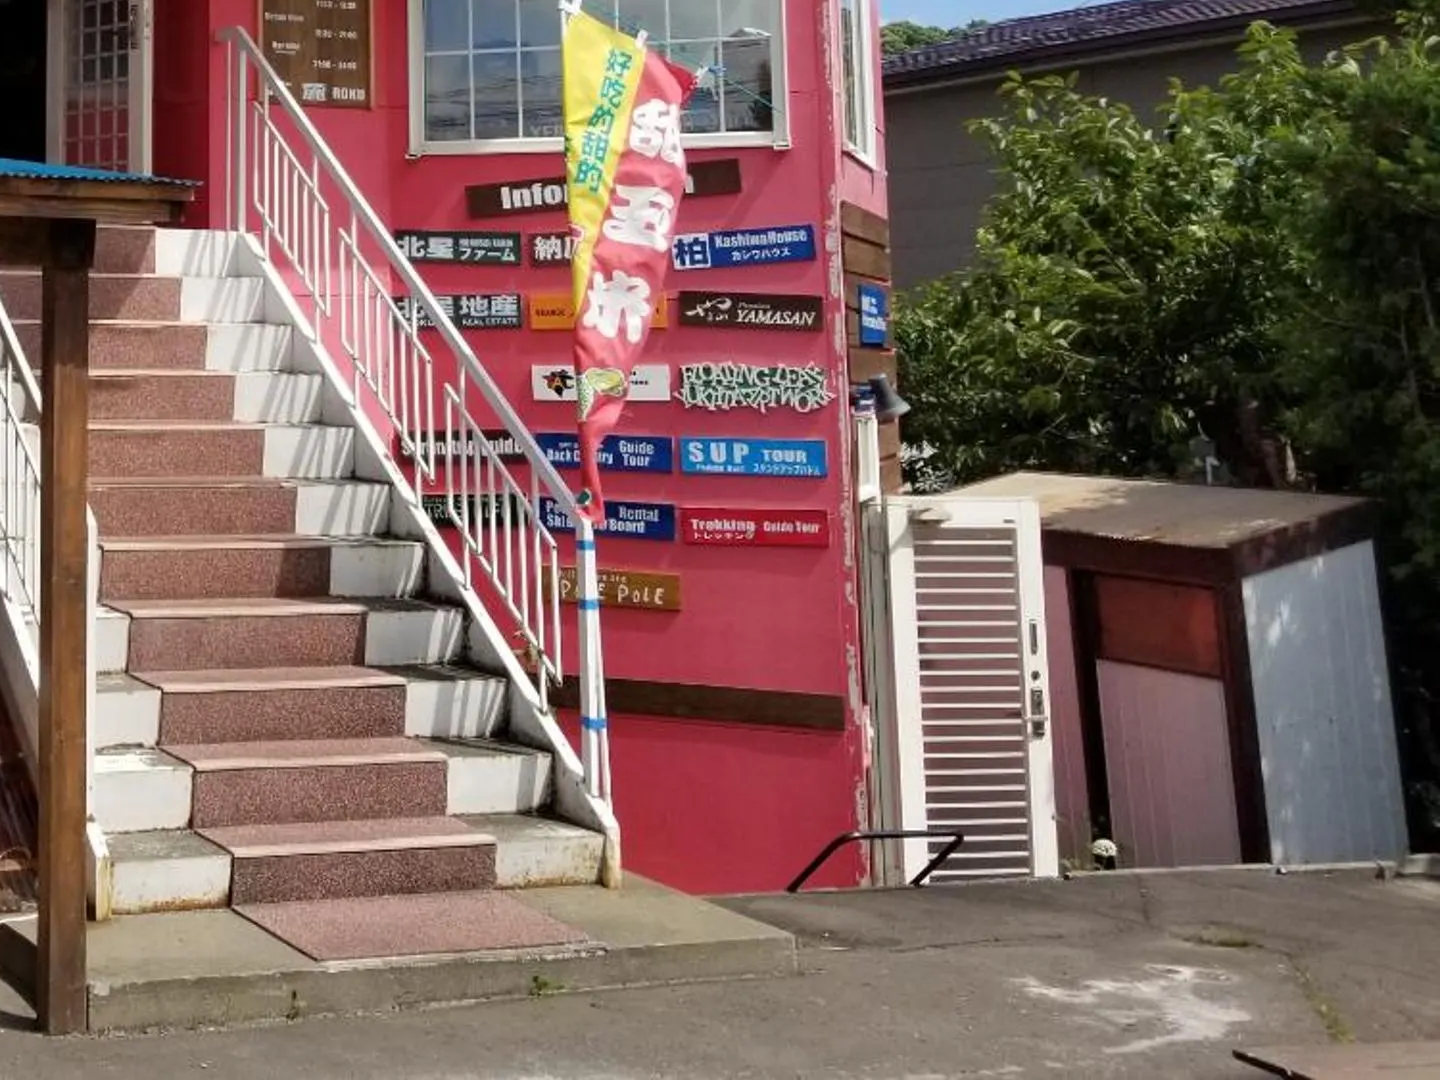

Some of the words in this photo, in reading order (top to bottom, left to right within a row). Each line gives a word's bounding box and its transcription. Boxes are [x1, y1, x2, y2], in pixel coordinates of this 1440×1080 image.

[674, 237, 709, 267] 柏
[731, 247, 792, 261] カシワハウス
[736, 309, 817, 327] YAMASAN
[619, 440, 655, 455] Guide
[622, 453, 651, 467] Tour
[762, 449, 808, 464] TOUR
[619, 506, 660, 522] Rental
[610, 518, 646, 534] Board
[690, 519, 756, 533] Trekking
